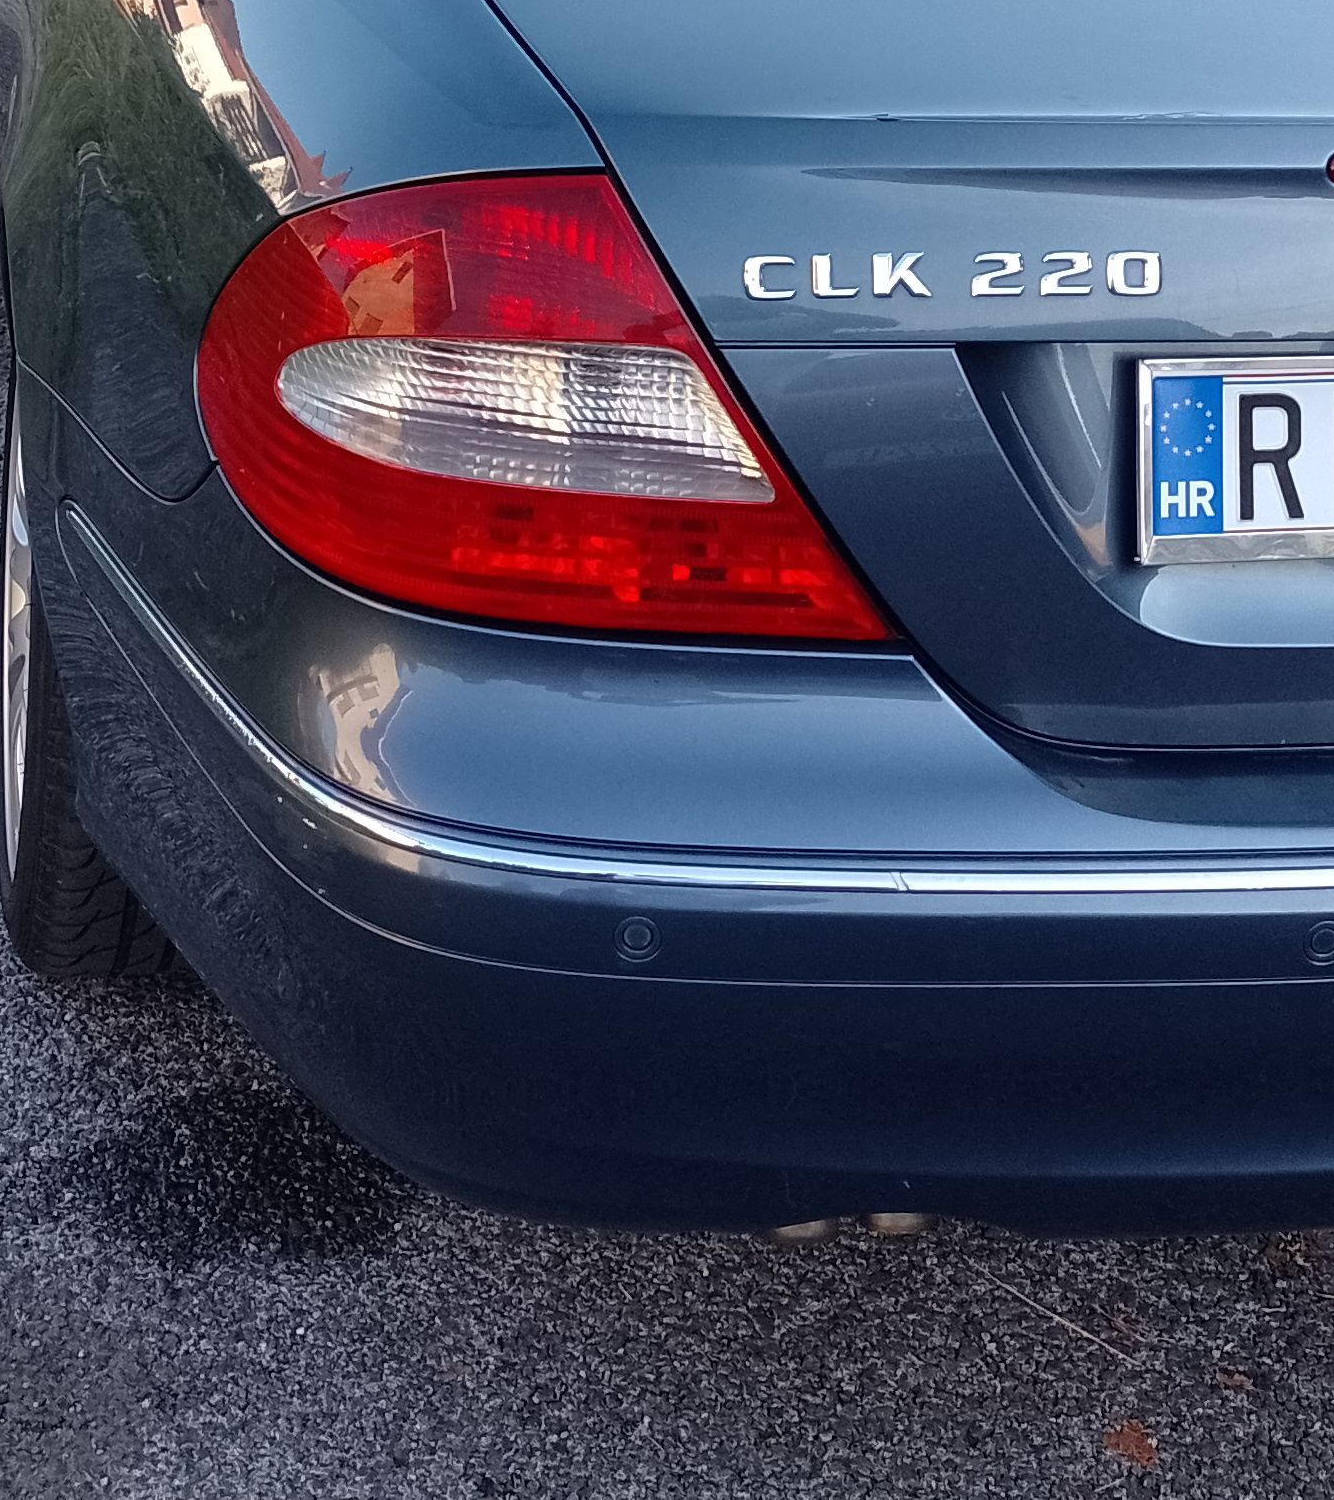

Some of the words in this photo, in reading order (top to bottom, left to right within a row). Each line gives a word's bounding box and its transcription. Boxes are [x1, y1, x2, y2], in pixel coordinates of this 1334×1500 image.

[742, 250, 933, 301] CLK
[970, 250, 1163, 298] 220
[1160, 480, 1216, 519] HR
